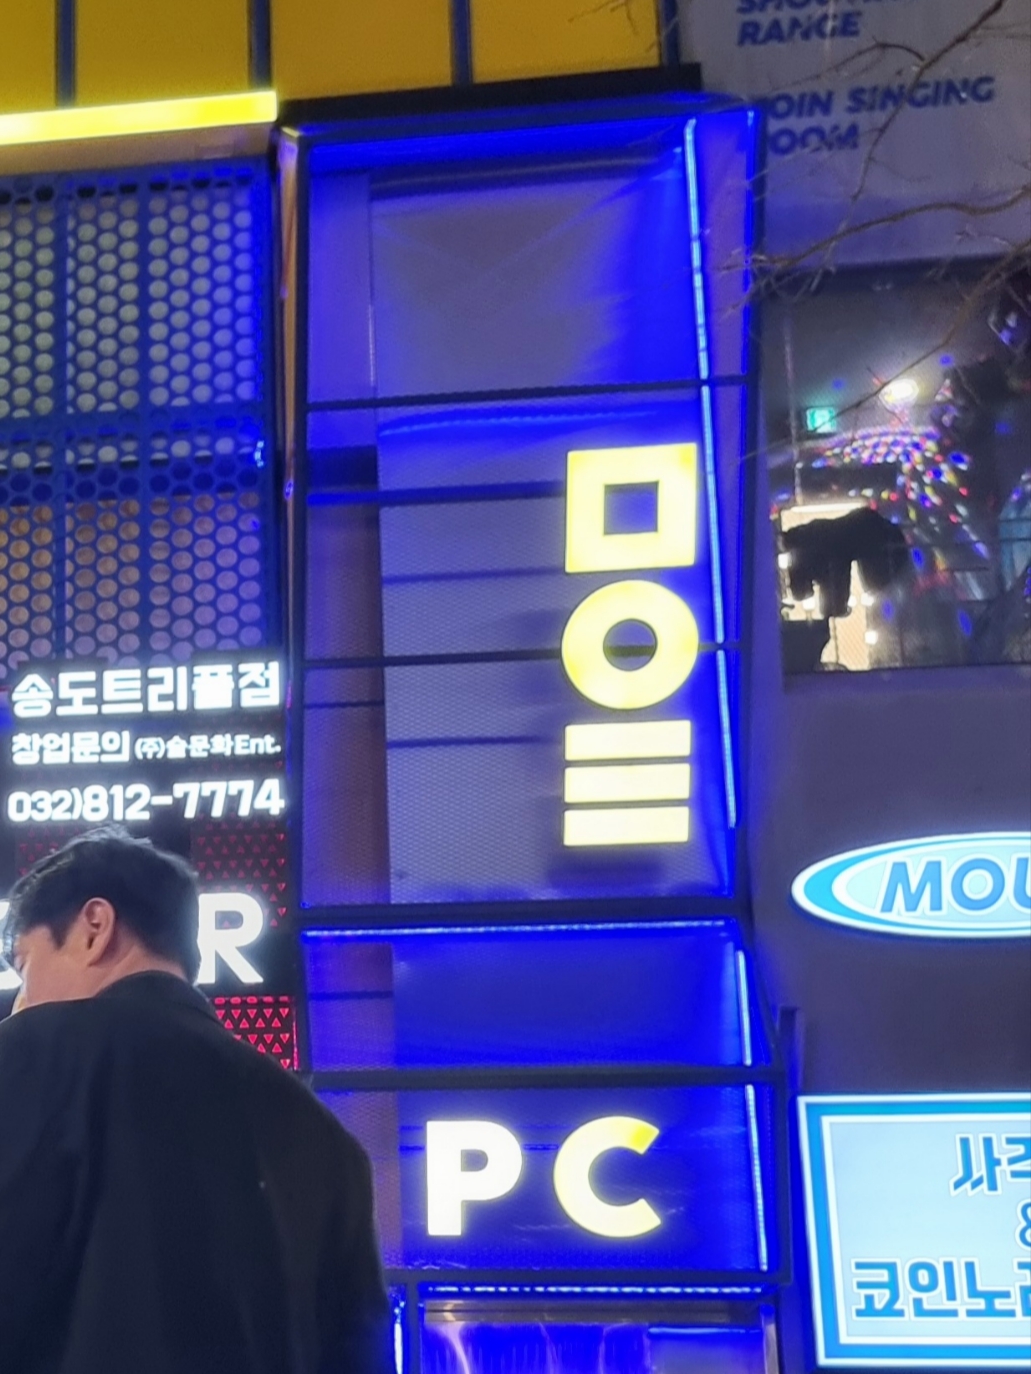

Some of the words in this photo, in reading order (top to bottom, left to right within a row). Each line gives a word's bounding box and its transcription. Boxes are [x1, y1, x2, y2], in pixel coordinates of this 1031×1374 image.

[737, 12, 862, 46] RANGE
[767, 89, 833, 120] OIN
[768, 123, 859, 155] OOM
[11, 661, 280, 718] 송도트리플점
[11, 730, 130, 765] 창업문의
[7, 778, 285, 822] 032)812-7774
[426, 1115, 662, 1237] PC
